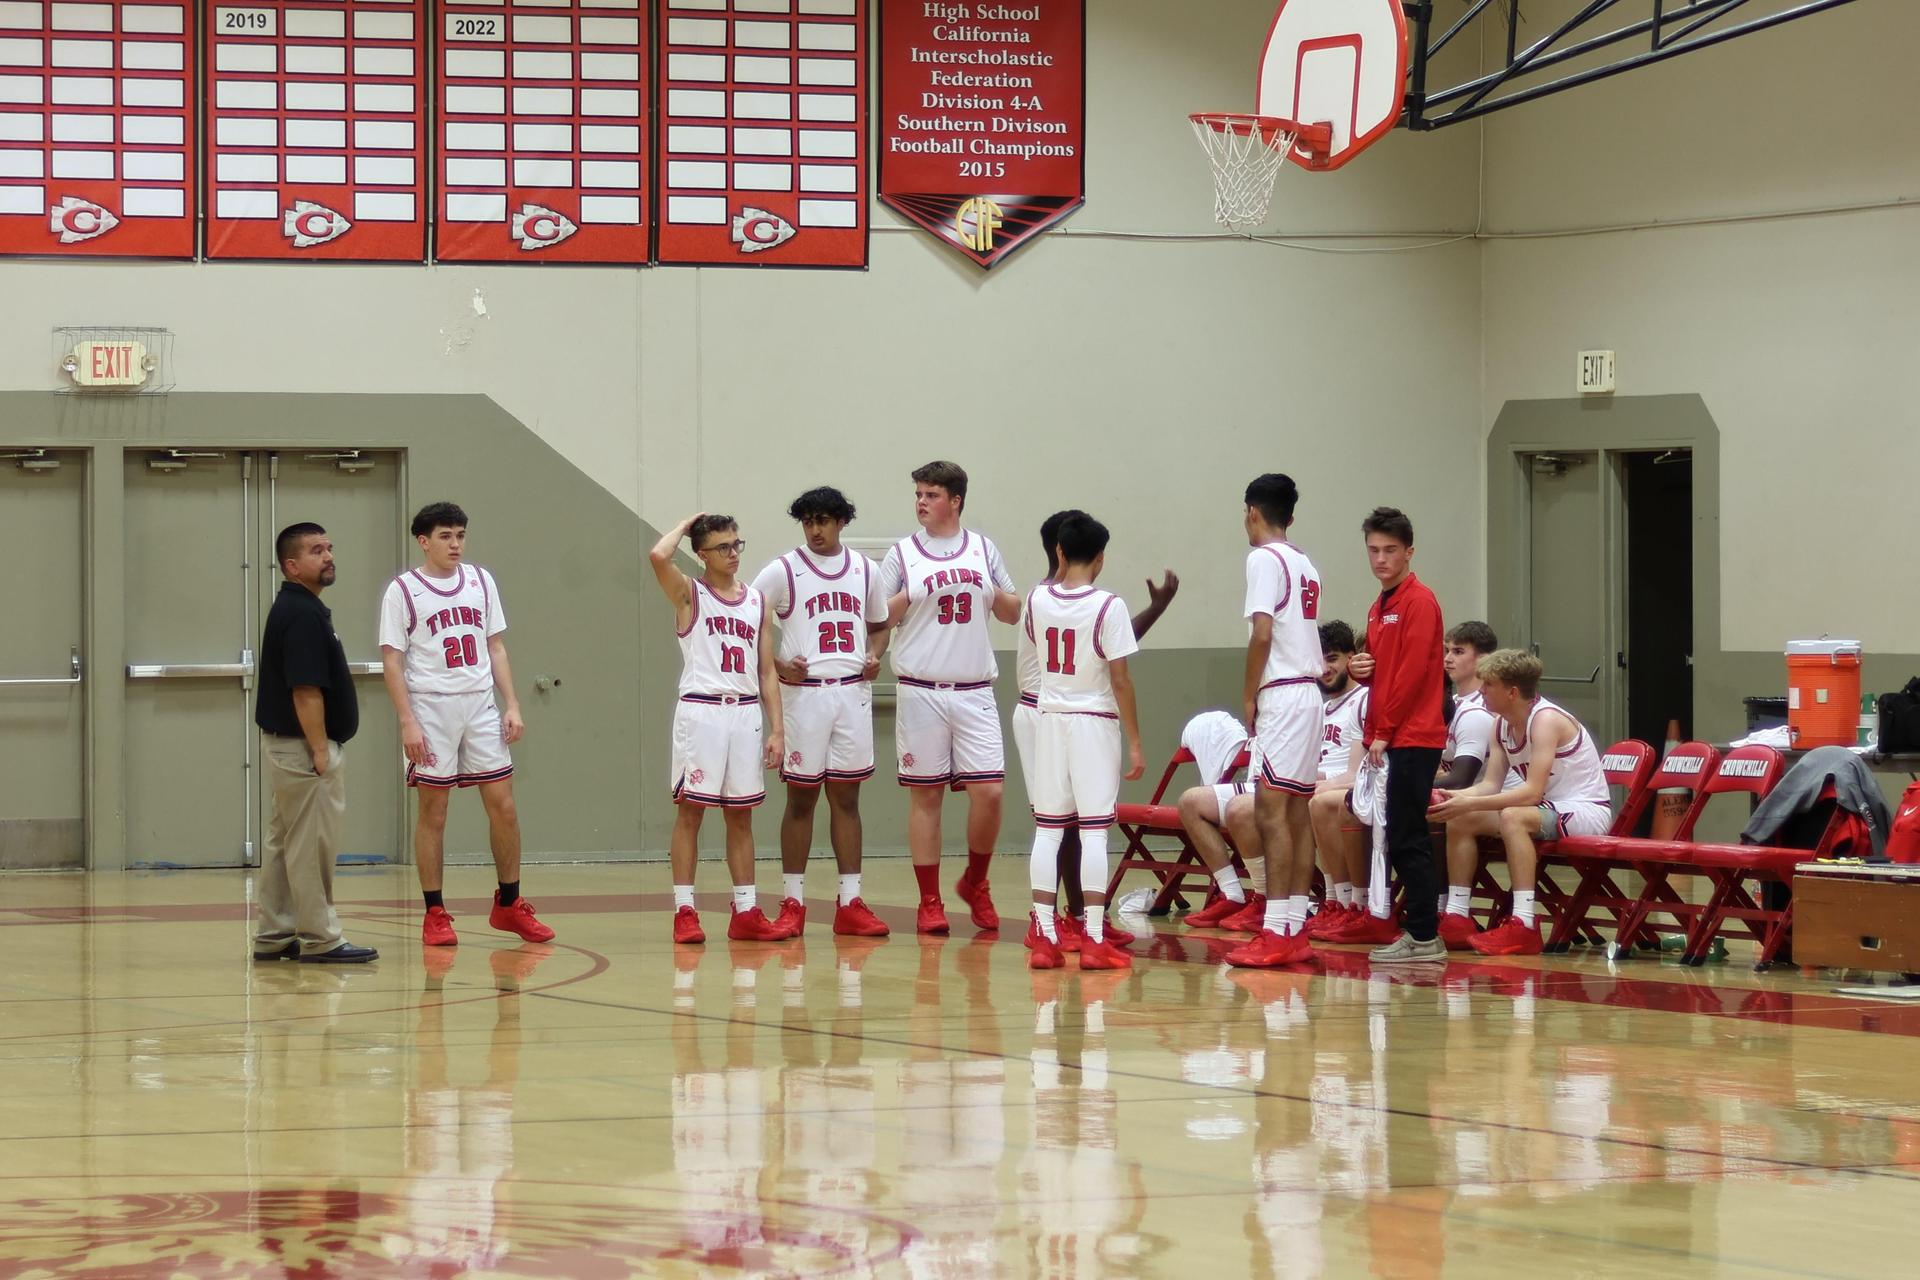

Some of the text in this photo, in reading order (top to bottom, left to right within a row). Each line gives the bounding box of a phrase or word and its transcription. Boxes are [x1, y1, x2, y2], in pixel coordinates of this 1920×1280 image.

[226, 13, 267, 28] 2019
[924, 2, 1040, 23] High School
[455, 20, 496, 35] 2022
[932, 25, 1031, 43] California
[911, 47, 1053, 66] Interscholastic
[931, 70, 1033, 88] Federation
[921, 92, 1044, 111] Division 4-A
[898, 114, 1067, 134] Southern Divison
[890, 137, 1074, 160] Football Champions
[959, 161, 1005, 177] 2015
[62, 207, 101, 233] C
[295, 211, 333, 238] C
[523, 215, 560, 241] C
[743, 217, 779, 243] C
[956, 197, 1004, 251] CIF
[92, 346, 132, 378] EXIT
[1583, 355, 1604, 386] EXIT
[923, 568, 983, 597] TRIBE
[805, 591, 862, 620] TRIBE
[938, 592, 972, 625] 33
[426, 606, 484, 637] TRIBE
[706, 615, 756, 648] TRIBE
[818, 621, 855, 653] 25
[443, 634, 478, 668] 20
[1045, 627, 1076, 675] 11
